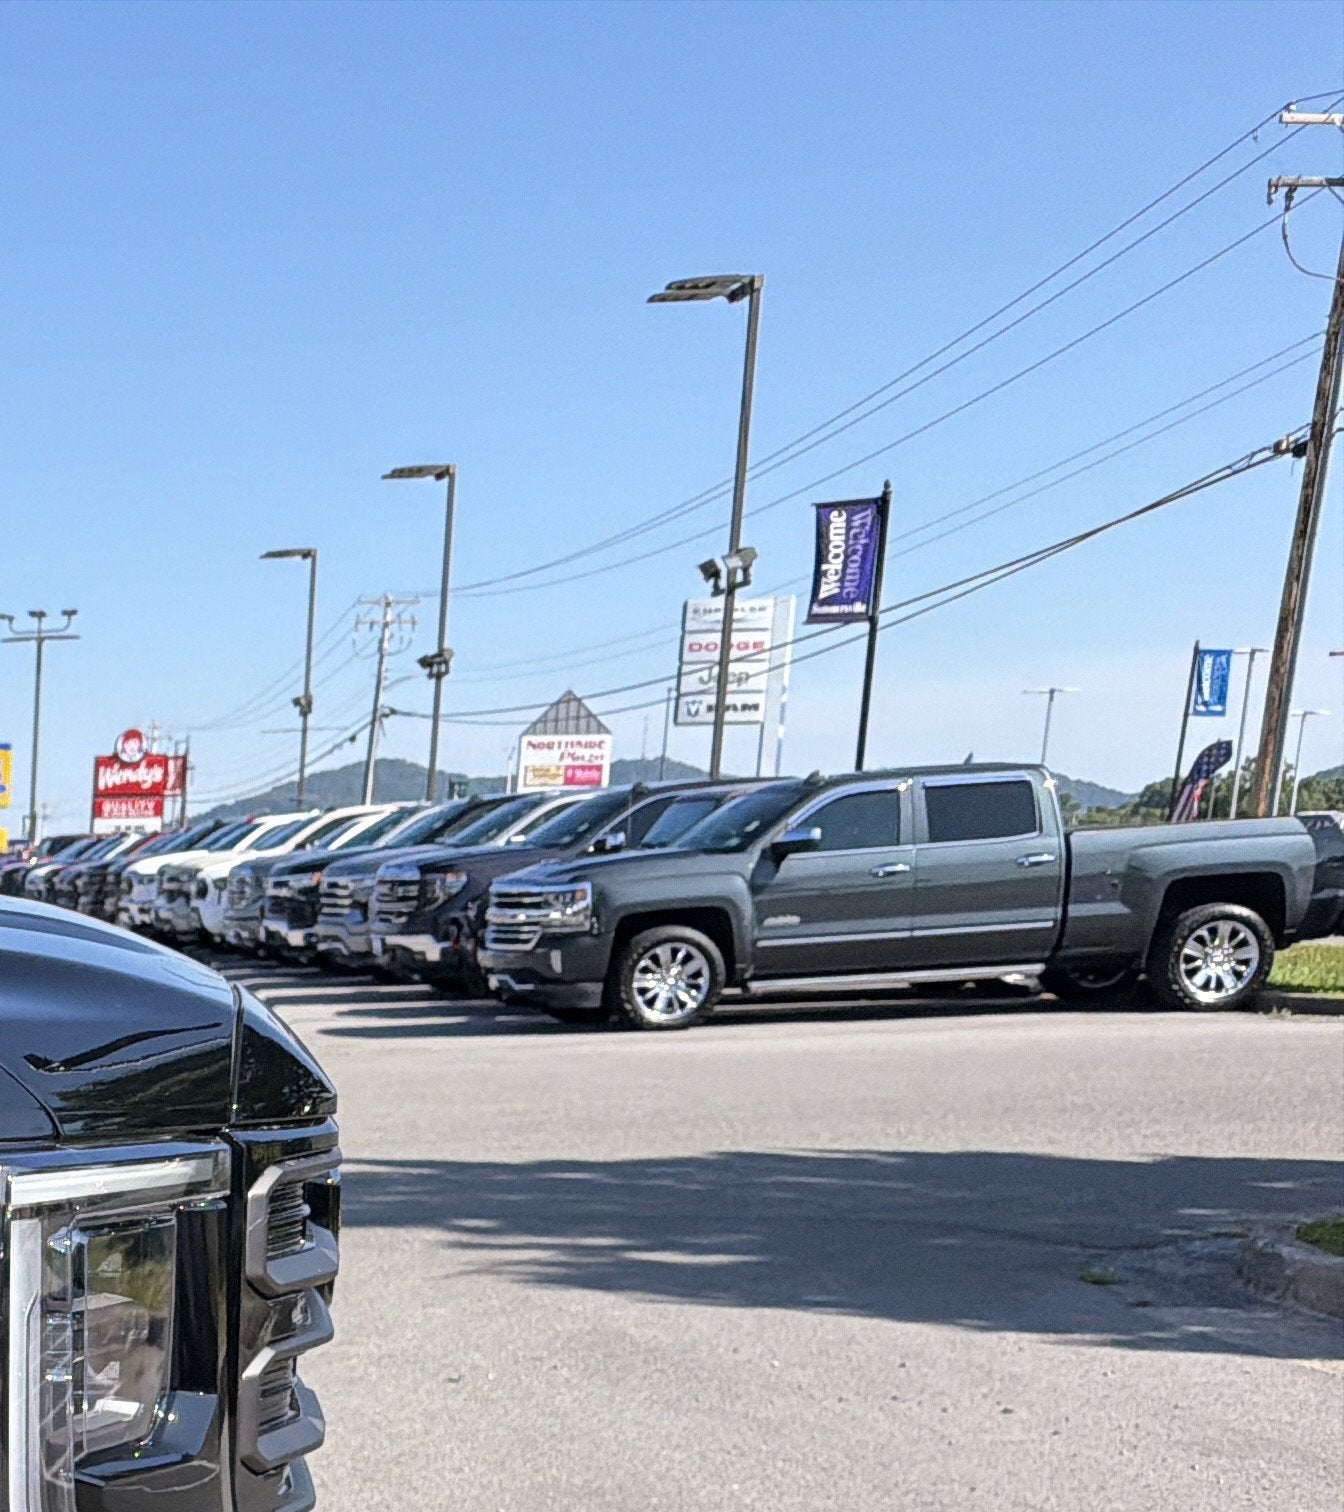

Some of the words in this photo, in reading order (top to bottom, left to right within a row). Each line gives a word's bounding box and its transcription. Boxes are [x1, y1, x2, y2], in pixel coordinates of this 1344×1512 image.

[817, 508, 847, 600] Welcome
[842, 507, 872, 599] Welcome
[688, 641, 765, 653] DOGE
